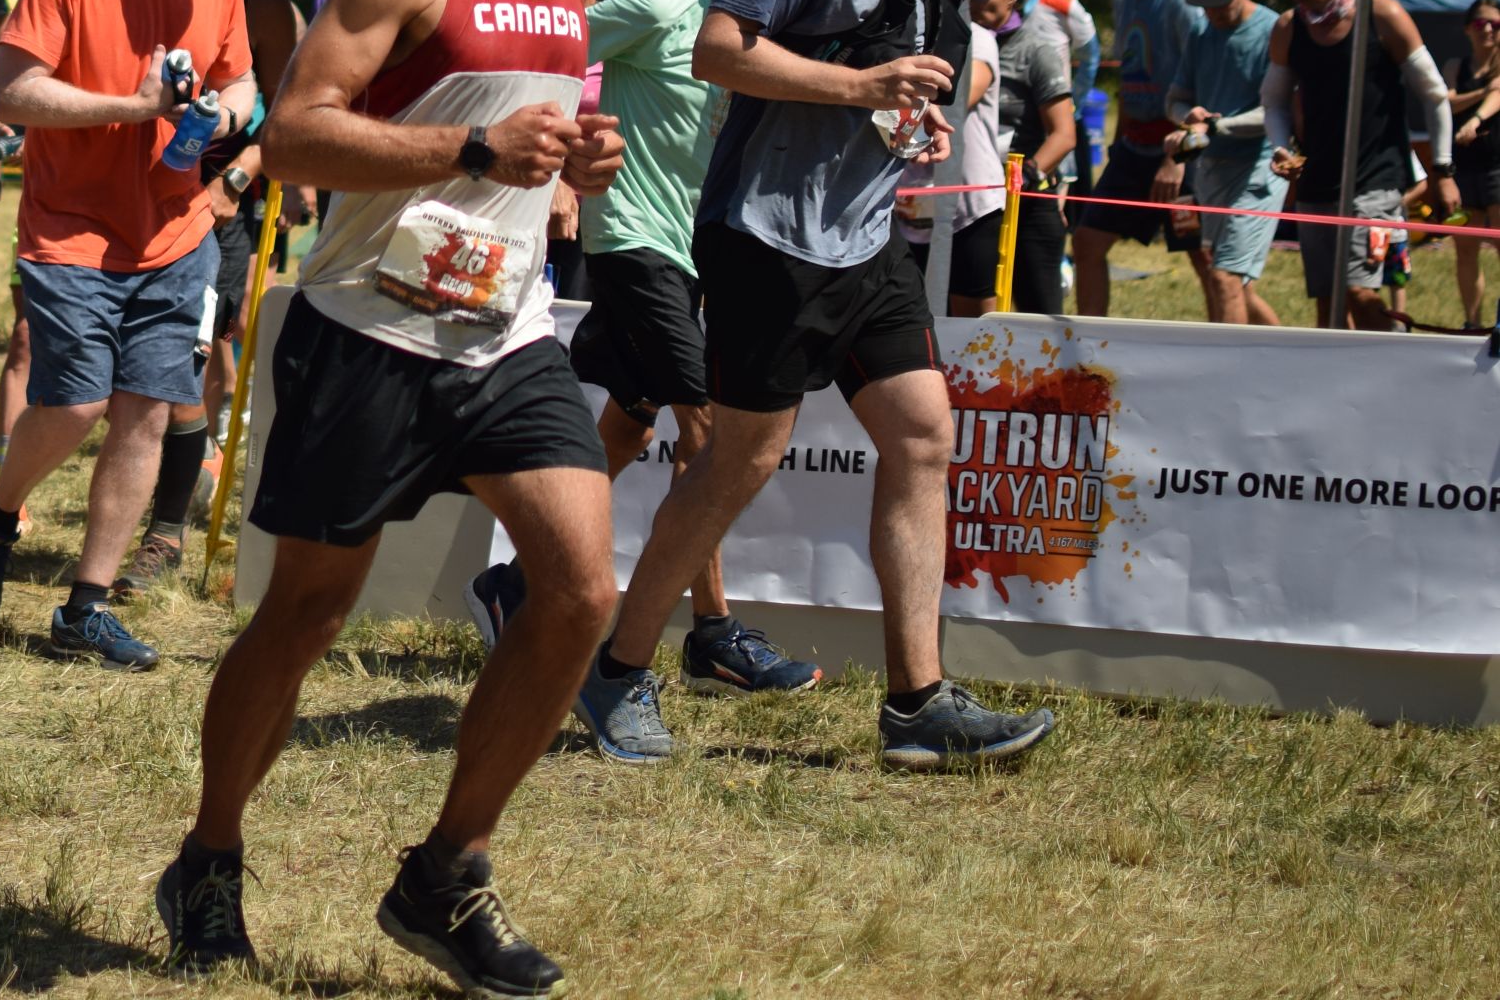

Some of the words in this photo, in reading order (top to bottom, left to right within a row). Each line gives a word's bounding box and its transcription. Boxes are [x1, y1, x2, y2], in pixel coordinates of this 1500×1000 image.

[473, 2, 582, 41] CANADA
[450, 243, 490, 276] 46
[438, 272, 475, 298] Rudy
[950, 409, 1108, 471] UTRUN
[805, 448, 866, 474] LINE
[946, 470, 1103, 521] CKYARD
[1154, 467, 1229, 500] JUST
[1237, 471, 1304, 500] ONE
[1314, 476, 1408, 507] MORE
[954, 521, 1046, 555] ULTRA
[1049, 536, 1072, 548] 4.167
